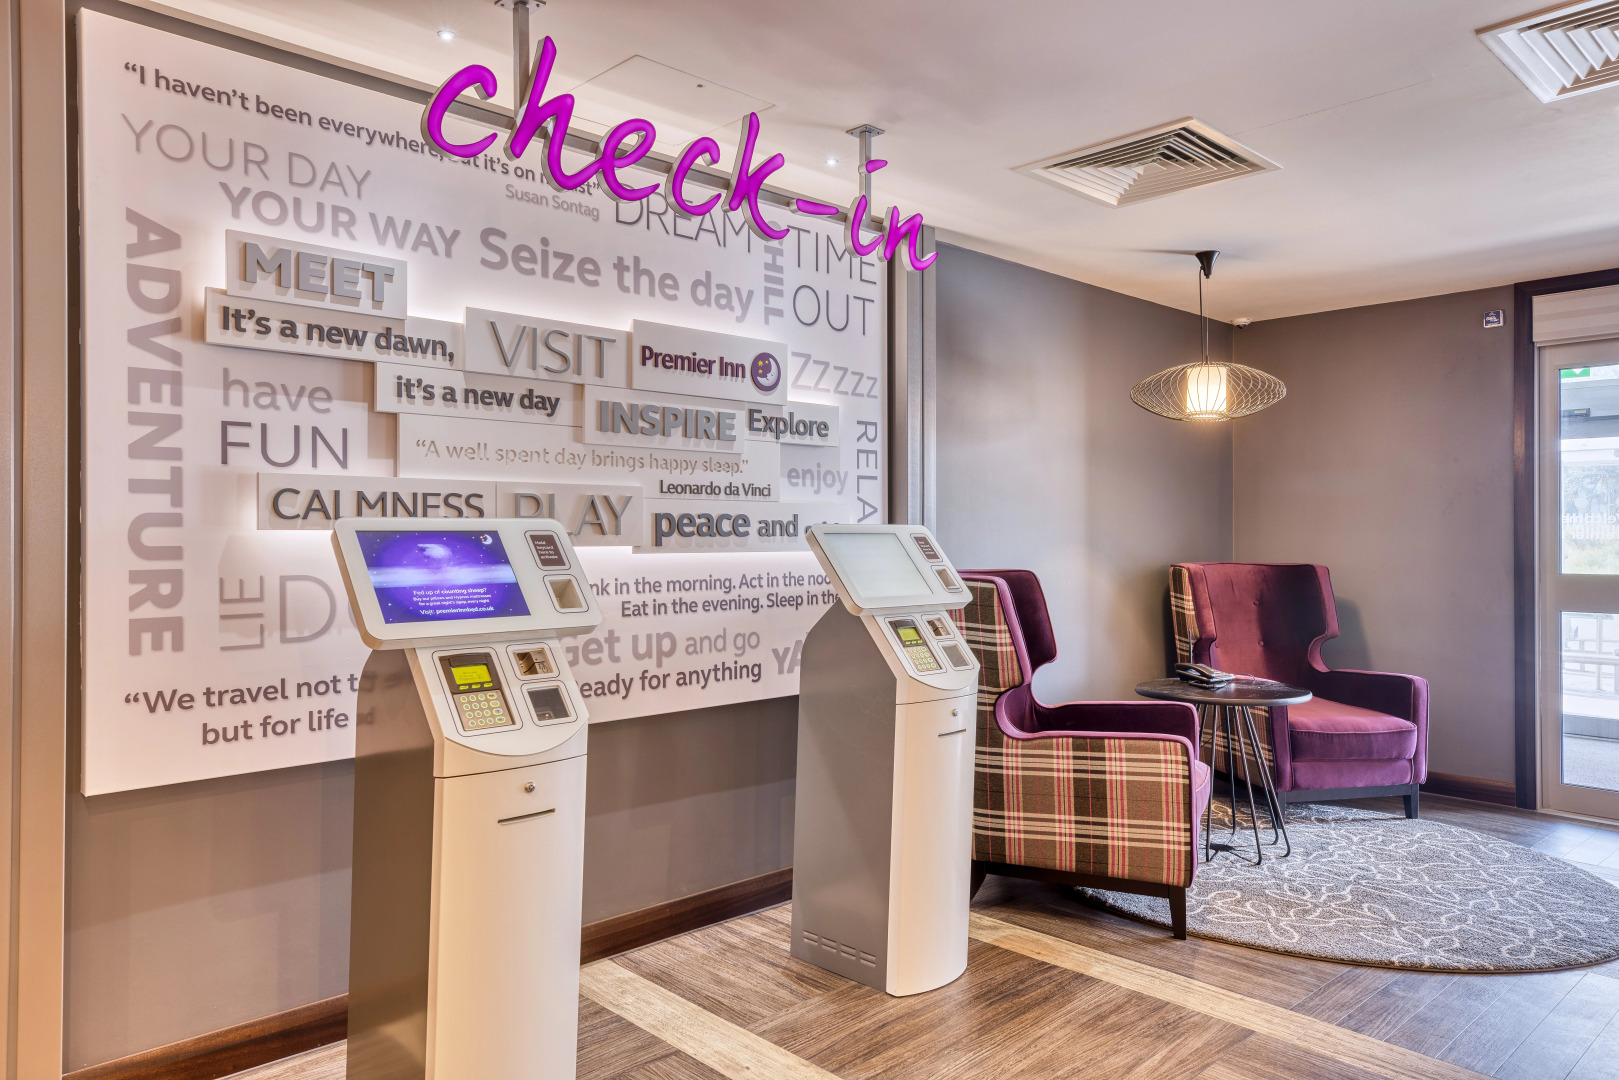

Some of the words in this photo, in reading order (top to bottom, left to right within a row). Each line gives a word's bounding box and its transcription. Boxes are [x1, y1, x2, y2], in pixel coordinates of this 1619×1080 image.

[155, 69, 249, 111] haven’t
[256, 95, 312, 126] been
[484, 153, 509, 175] it’s
[514, 165, 535, 182] on
[121, 113, 270, 181] YOUR
[289, 151, 371, 200] DAY
[420, 36, 938, 271] check-in
[219, 181, 358, 241] YOUR
[369, 212, 461, 259] WAY
[505, 184, 548, 207] Susan
[552, 195, 600, 222] Sontag
[615, 183, 750, 253] DREAM
[245, 242, 395, 302] MEET
[479, 227, 601, 288] Seize
[613, 255, 680, 301] the
[690, 270, 755, 323] day
[787, 224, 877, 285] TIME
[792, 284, 874, 336] OUT
[222, 305, 271, 335] It’s
[280, 318, 299, 339] a
[307, 322, 368, 347] new
[375, 327, 455, 362] dawn,
[490, 320, 617, 379] VISIT
[640, 345, 714, 376] Premier
[719, 356, 746, 380] Inn
[222, 368, 333, 414] have
[396, 375, 435, 401] it’s
[442, 386, 457, 403] a
[464, 388, 514, 408] new
[519, 388, 560, 417] day
[125, 206, 184, 656] ADVENTURE
[600, 400, 736, 441] INSPIRE
[749, 409, 830, 439] Explore
[221, 421, 348, 469] FUN
[446, 443, 489, 462] well
[495, 446, 549, 469] spent
[554, 447, 586, 469] day
[591, 451, 644, 471] brings
[649, 454, 698, 475] happy
[659, 480, 721, 497] Leonardo
[723, 482, 740, 497] da
[742, 483, 771, 498] Vinci
[786, 463, 849, 495] enjoy
[856, 420, 878, 524] RELA
[655, 512, 751, 546] peace
[757, 514, 799, 538] and
[614, 577, 630, 595] in
[634, 577, 662, 595] the
[666, 574, 736, 595] morning.
[739, 573, 764, 590] Act
[767, 572, 779, 588] in
[782, 571, 805, 587] the
[621, 600, 649, 618] Eat
[653, 598, 668, 616] in
[672, 598, 698, 614] the
[702, 595, 764, 613] evening.
[767, 592, 804, 610] Sleep
[807, 590, 819, 605] in
[821, 589, 841, 604] the
[220, 575, 264, 651] LIE
[631, 629, 677, 669] up
[685, 627, 727, 656] and
[733, 630, 761, 657] go
[202, 675, 288, 709] travel
[295, 673, 342, 701] not
[577, 673, 633, 700] eady
[639, 669, 671, 691] for
[676, 661, 762, 690] anything
[201, 721, 253, 747] but
[259, 714, 304, 740] for
[307, 708, 349, 734] life
